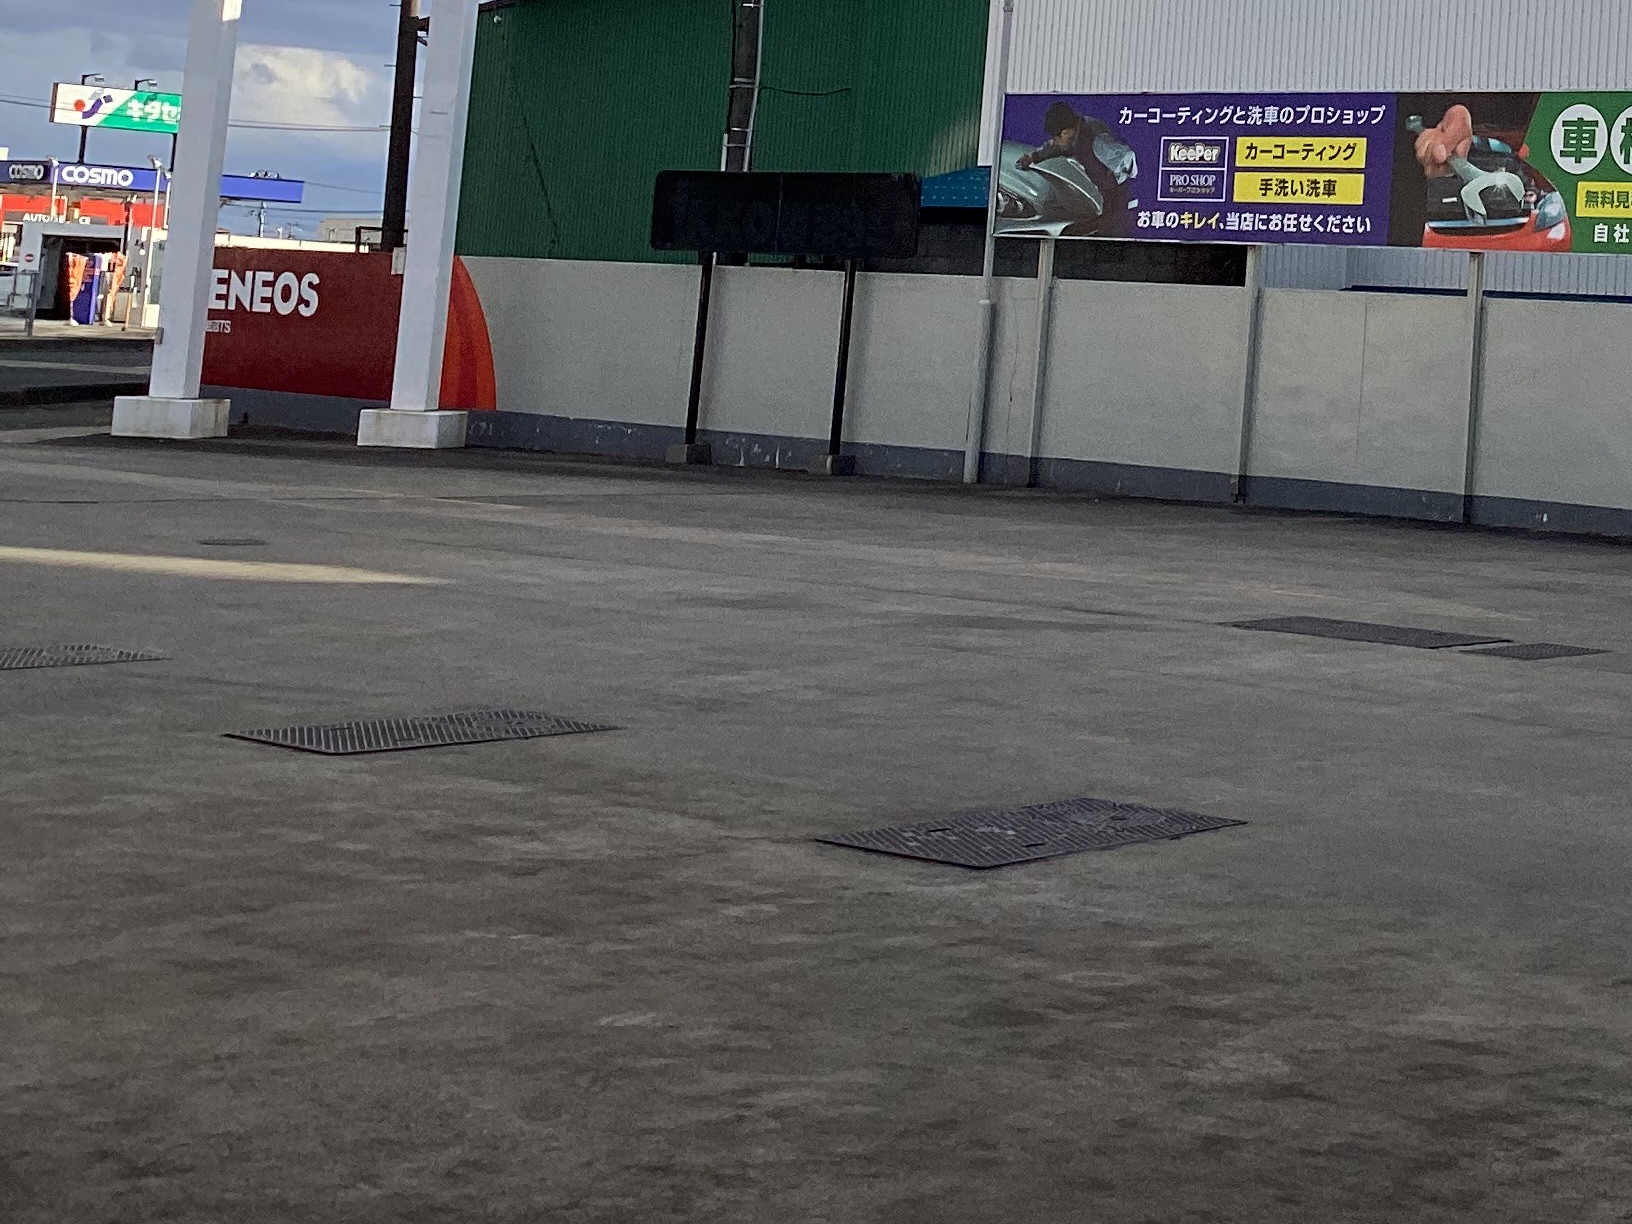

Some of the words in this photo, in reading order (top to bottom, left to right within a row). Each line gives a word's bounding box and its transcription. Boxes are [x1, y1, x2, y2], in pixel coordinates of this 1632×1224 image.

[1118, 105, 1386, 126] カーコーティングと洗車のプロショップ
[1169, 143, 1220, 162] KeePer
[1245, 142, 1358, 162] カーコーティング
[9, 164, 44, 180] COSMO
[61, 166, 134, 187] COSMO
[1169, 174, 1190, 186] PRO
[1190, 174, 1216, 186] SHOP
[1258, 178, 1337, 198] 手洗い洗車
[1136, 211, 1372, 234] お車のキレイ、当店にお任せください
[208, 268, 320, 317] ENEOS
